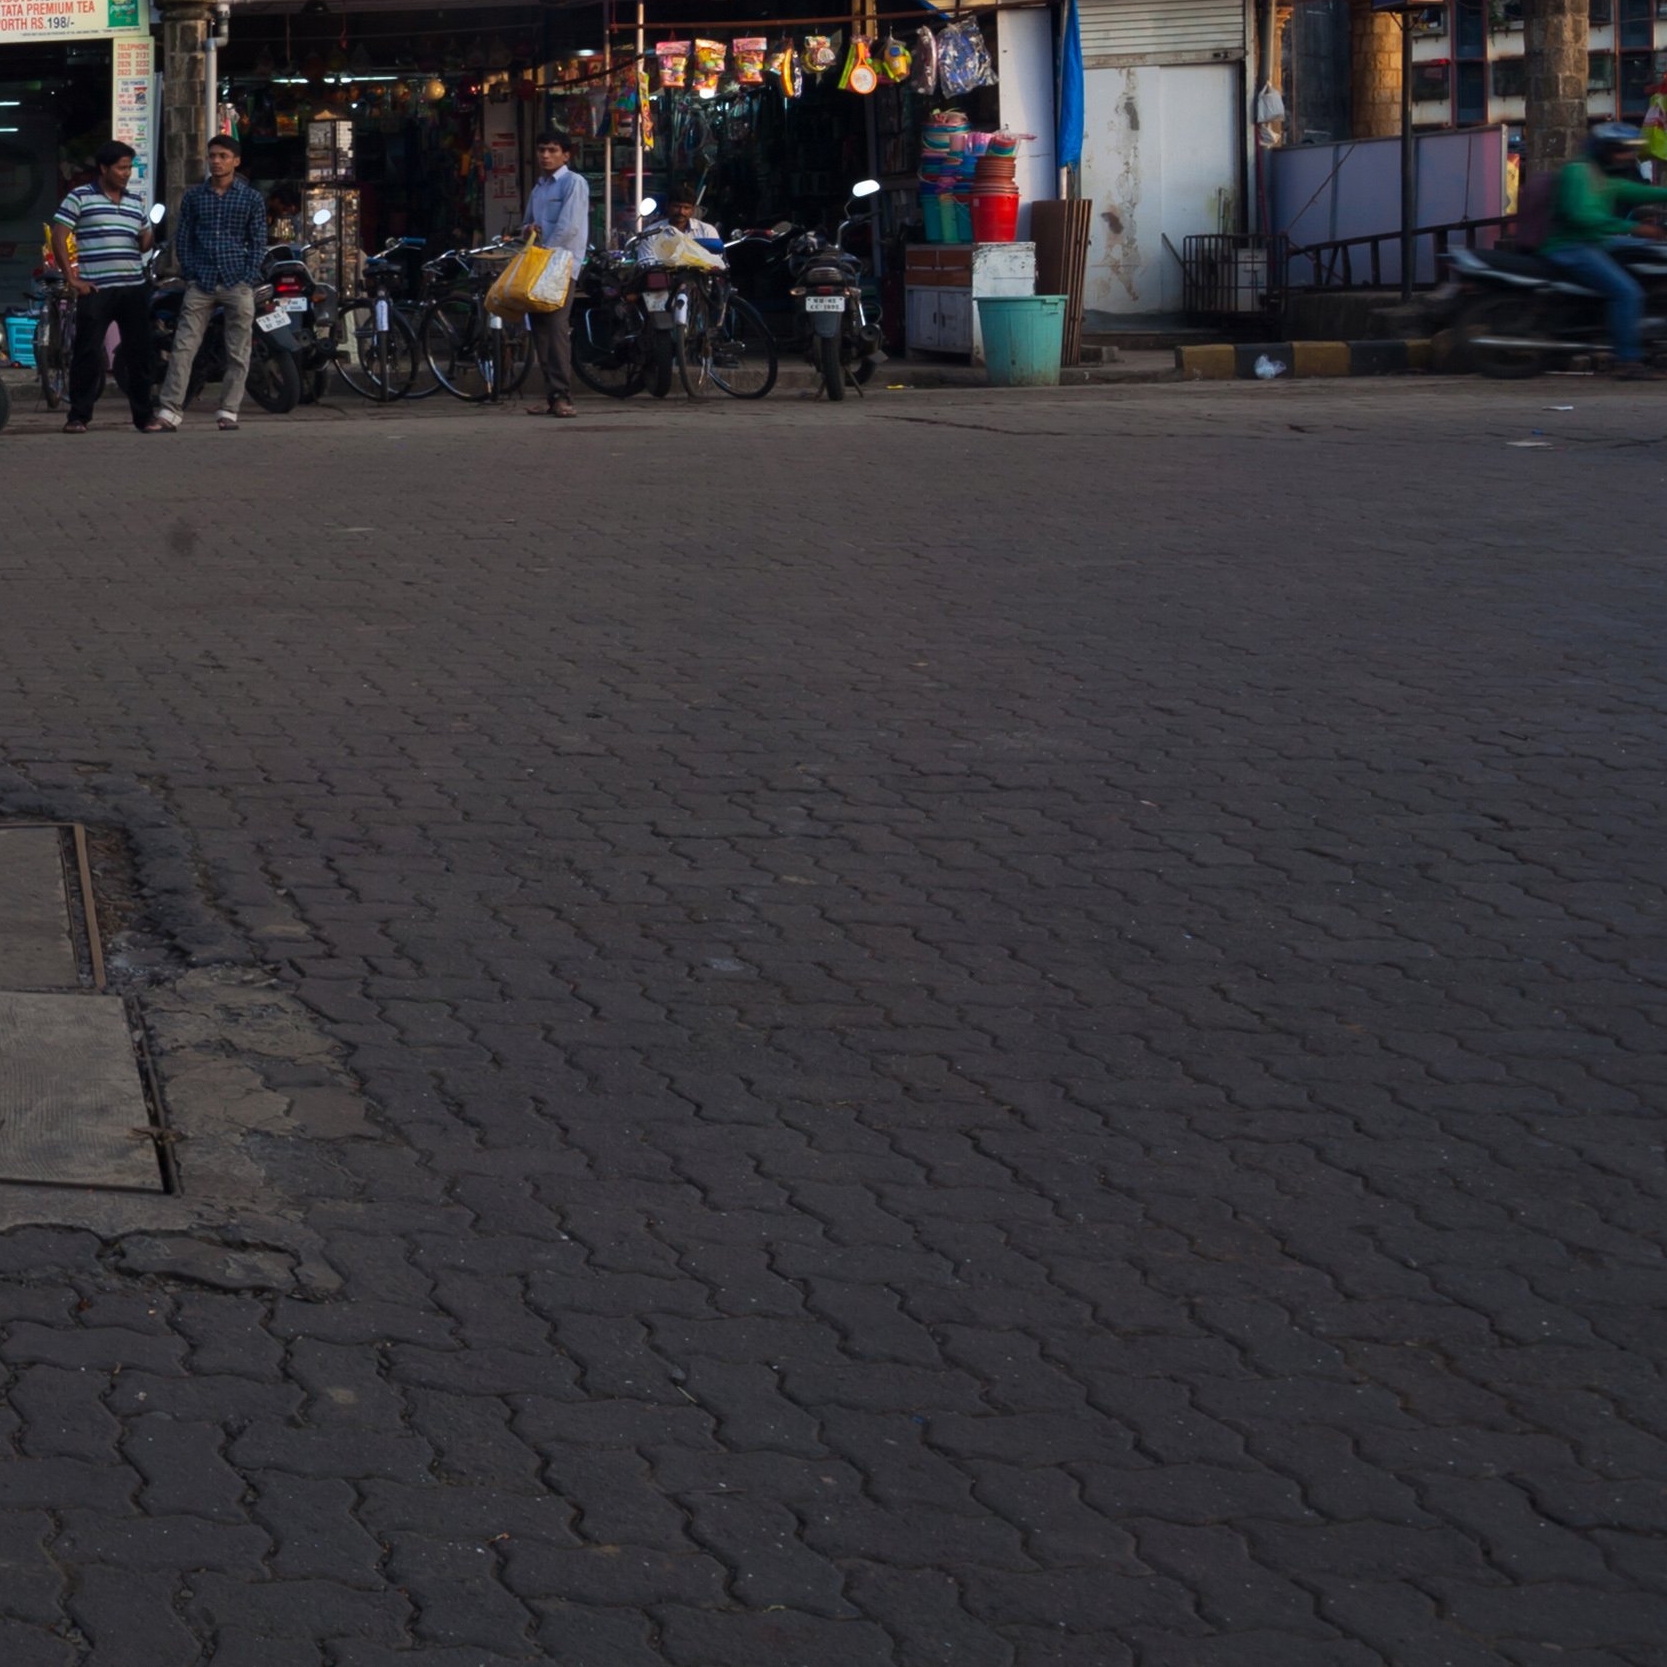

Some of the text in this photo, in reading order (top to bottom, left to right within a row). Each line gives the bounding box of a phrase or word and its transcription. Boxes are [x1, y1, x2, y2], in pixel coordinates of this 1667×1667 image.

[1, 4, 23, 17] TATA
[26, 2, 74, 15] PREMIUM
[77, 0, 95, 13] TEA
